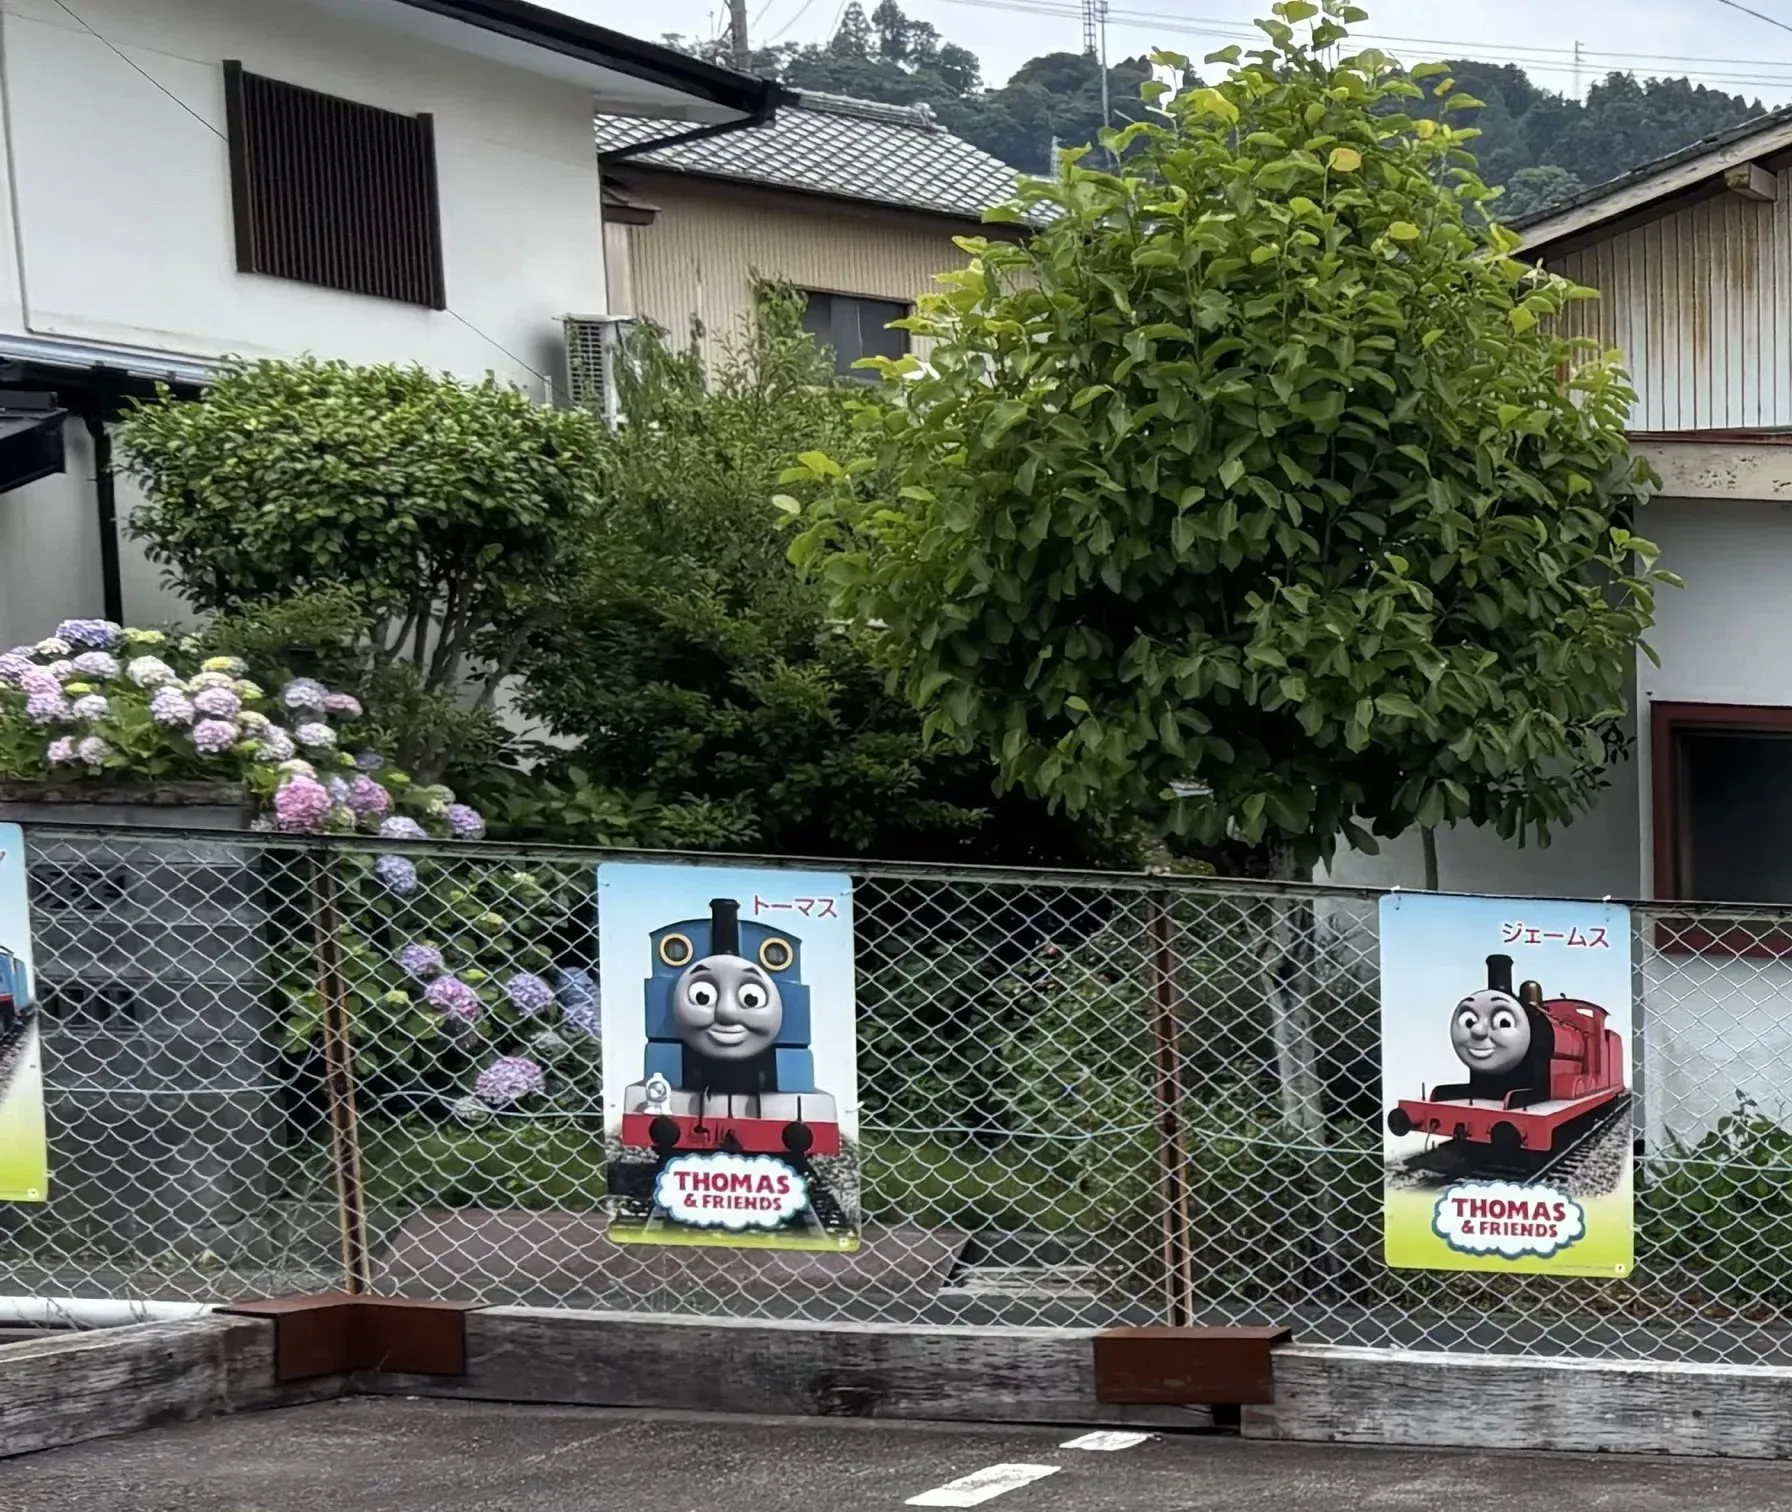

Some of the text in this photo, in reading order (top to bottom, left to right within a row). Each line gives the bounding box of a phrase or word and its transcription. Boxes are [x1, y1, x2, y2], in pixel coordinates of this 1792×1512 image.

[754, 894, 838, 918] トーマス
[1502, 922, 1610, 948] ジェームス
[674, 1171, 790, 1194] THOMAS
[684, 1193, 782, 1211] & FRIENDS
[1452, 1198, 1566, 1222] THOMAS
[1461, 1220, 1558, 1238] & FRIENDS
